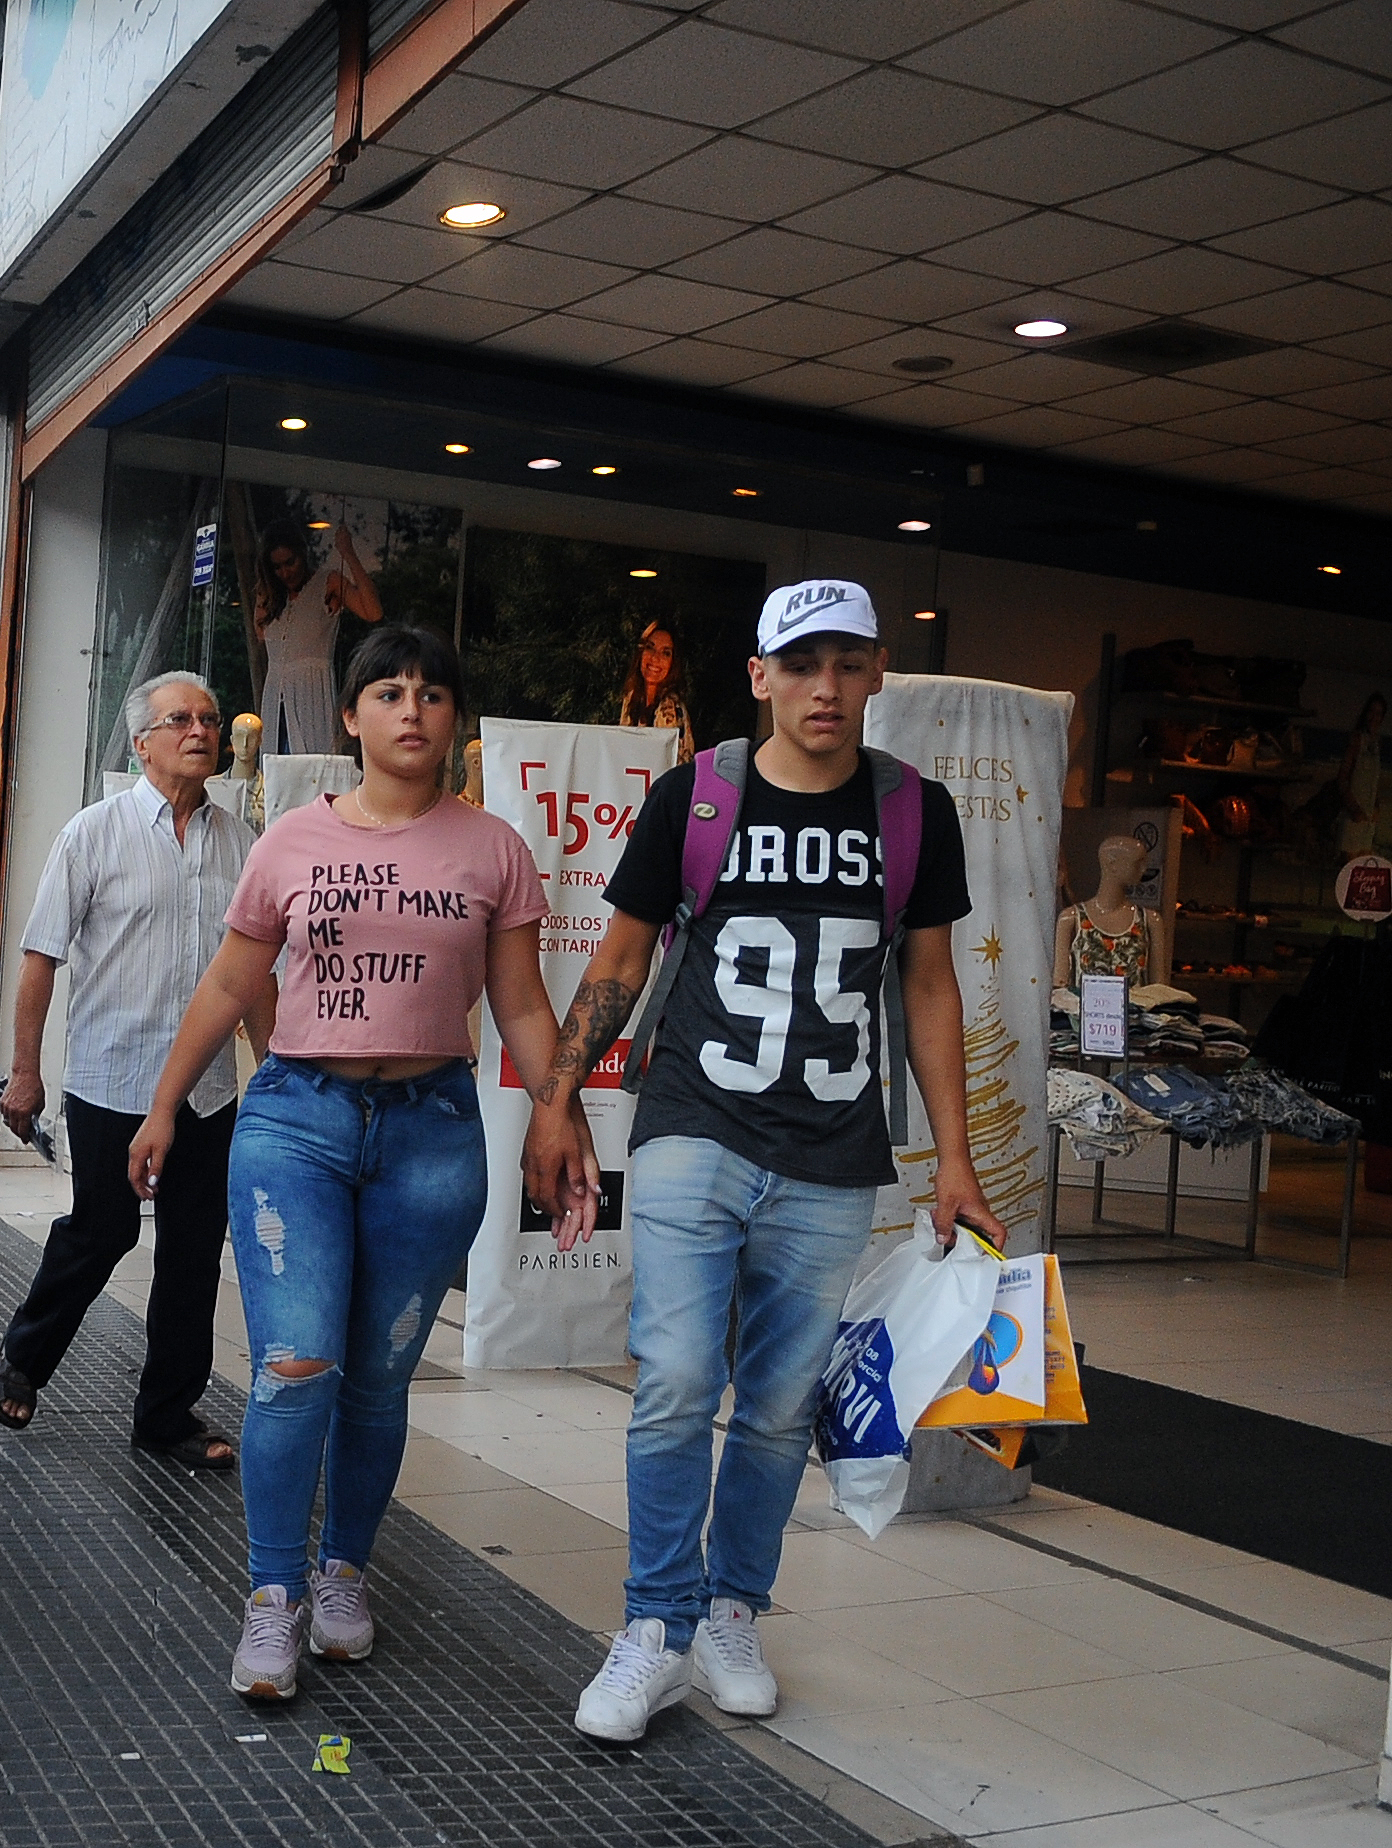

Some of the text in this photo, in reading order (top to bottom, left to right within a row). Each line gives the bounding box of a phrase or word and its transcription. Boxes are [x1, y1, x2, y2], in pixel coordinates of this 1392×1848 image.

[785, 586, 846, 616] RUN
[934, 756, 1012, 783] FELICES
[535, 791, 637, 855] 15%
[952, 795, 1011, 821] ESTAS
[311, 863, 400, 888] PLEASE
[559, 870, 607, 887] EXTRA
[308, 888, 469, 920] DON'T MAKE
[308, 918, 343, 949] ME
[540, 916, 602, 931] ODOS LOS
[314, 952, 426, 984] DO STUFF
[317, 988, 370, 1021] EVER.
[699, 916, 881, 1101] 95
[1089, 1023, 1117, 1037] $719
